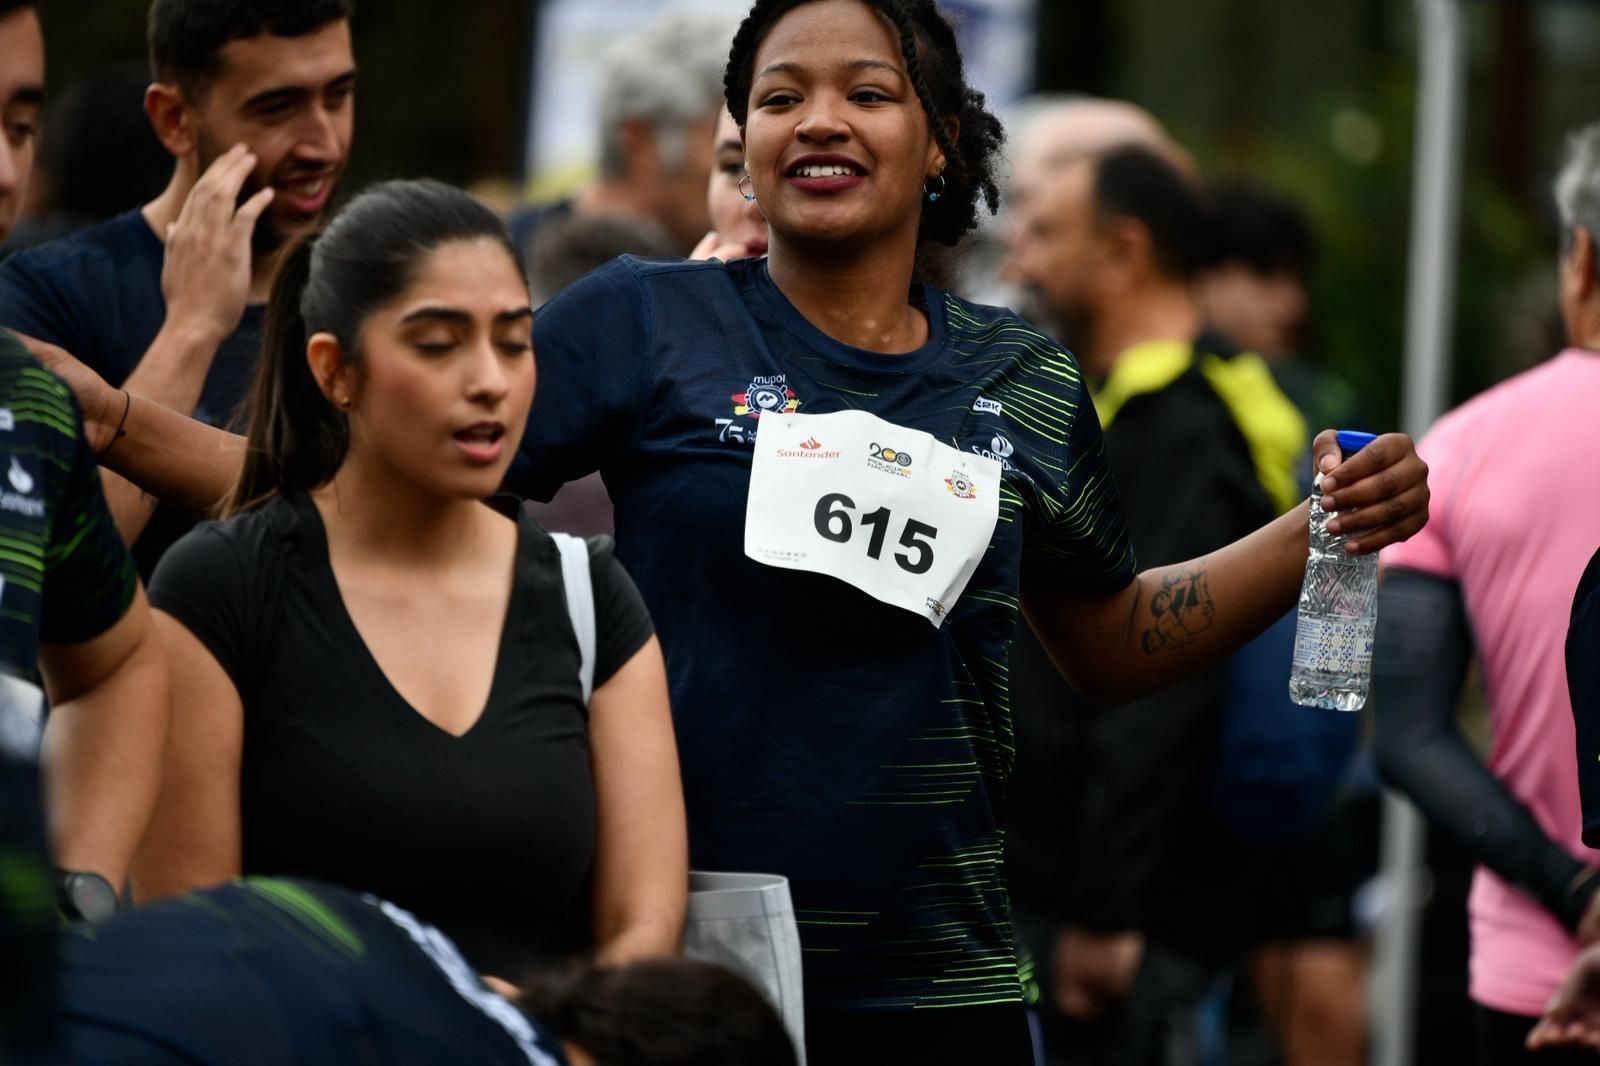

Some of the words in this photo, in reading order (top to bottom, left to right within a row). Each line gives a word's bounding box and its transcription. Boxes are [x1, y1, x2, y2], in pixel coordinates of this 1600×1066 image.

[753, 374, 785, 386] mupol
[715, 418, 744, 443] 75
[777, 449, 840, 459] Santander
[869, 442, 912, 467] 200
[814, 493, 938, 575] 615
